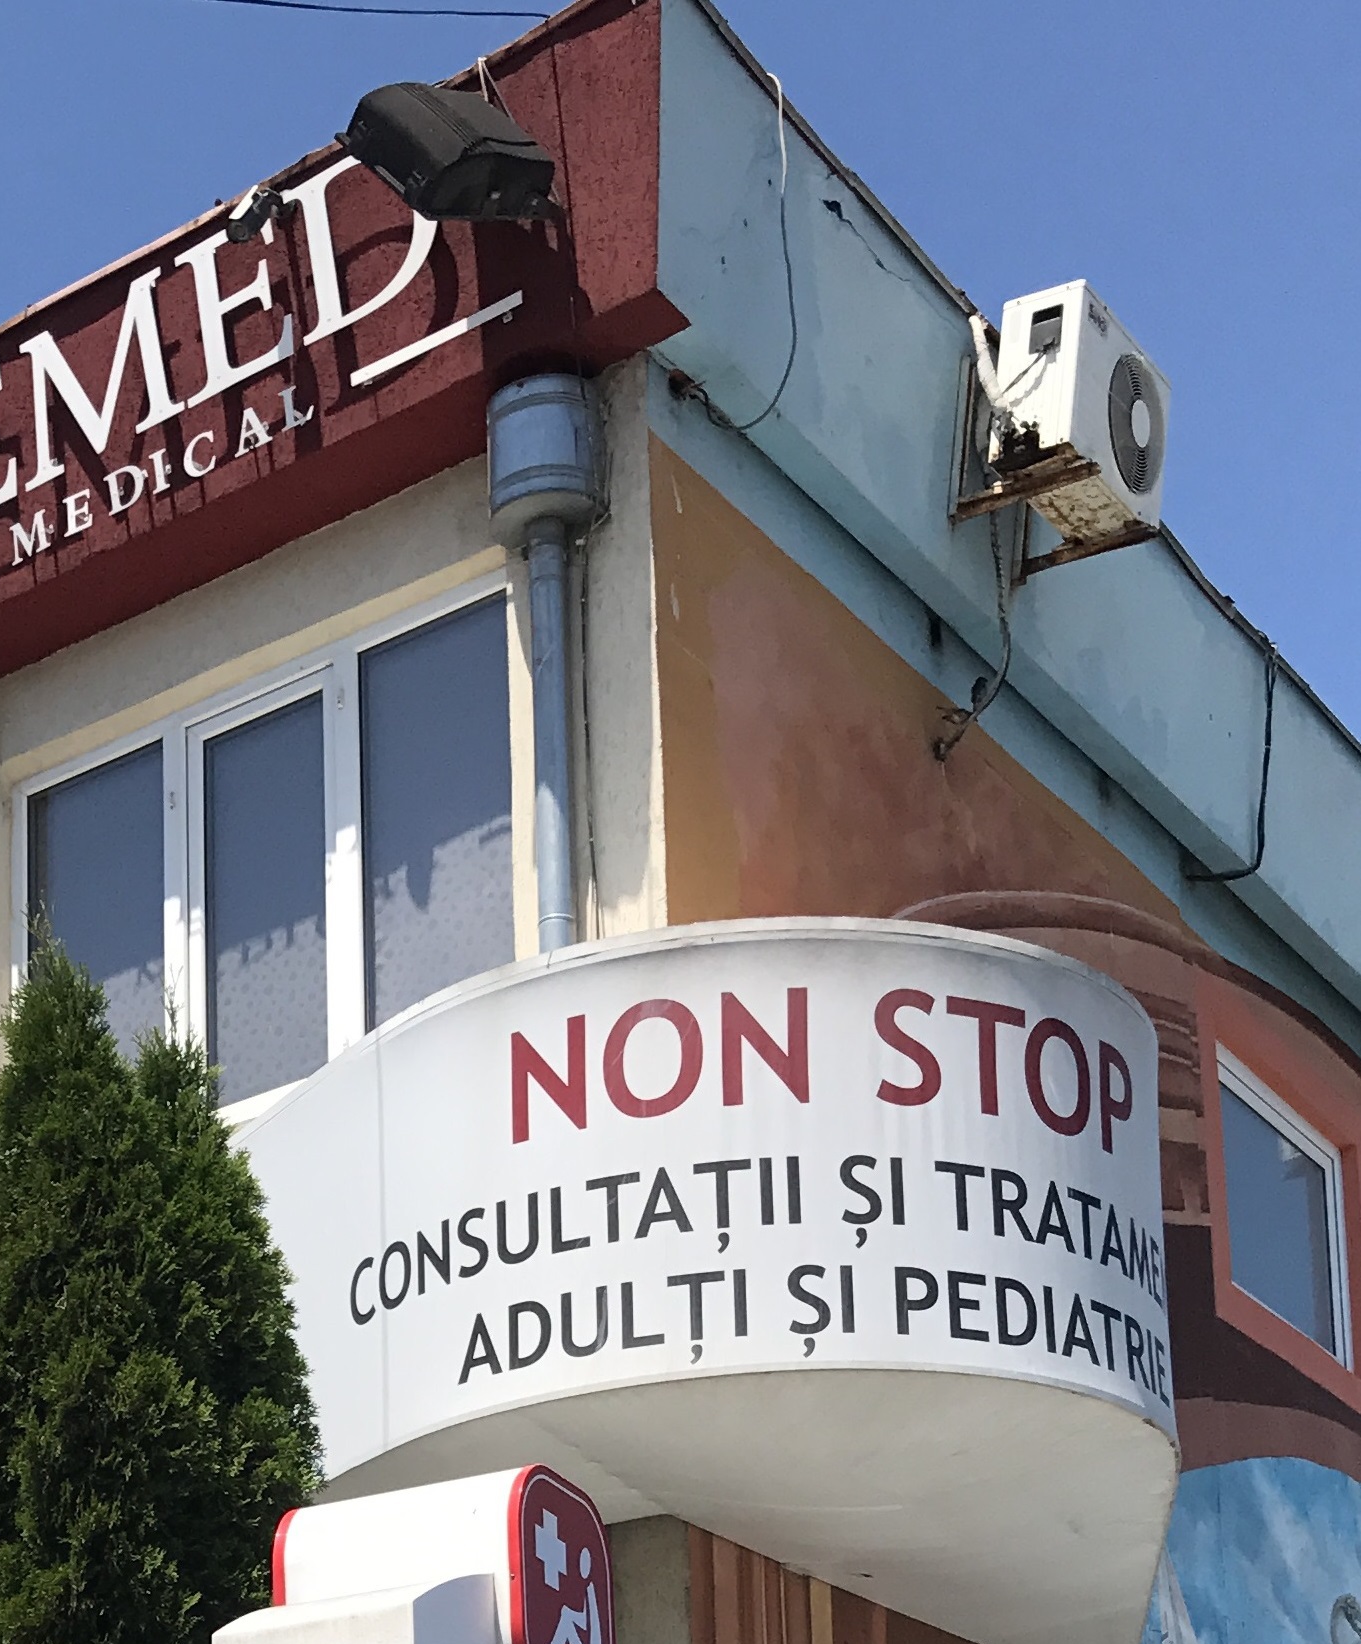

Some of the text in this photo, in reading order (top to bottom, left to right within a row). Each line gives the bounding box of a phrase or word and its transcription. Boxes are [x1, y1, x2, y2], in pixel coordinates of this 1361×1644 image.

[8, 385, 314, 567] MEDICAL
[510, 986, 1133, 1154] NON STOP
[349, 1155, 802, 1327] CONSULTAȚII
[840, 1154, 906, 1249] ȘI
[457, 1263, 1170, 1408] ADULȚI ȘI PEDIATRIE
